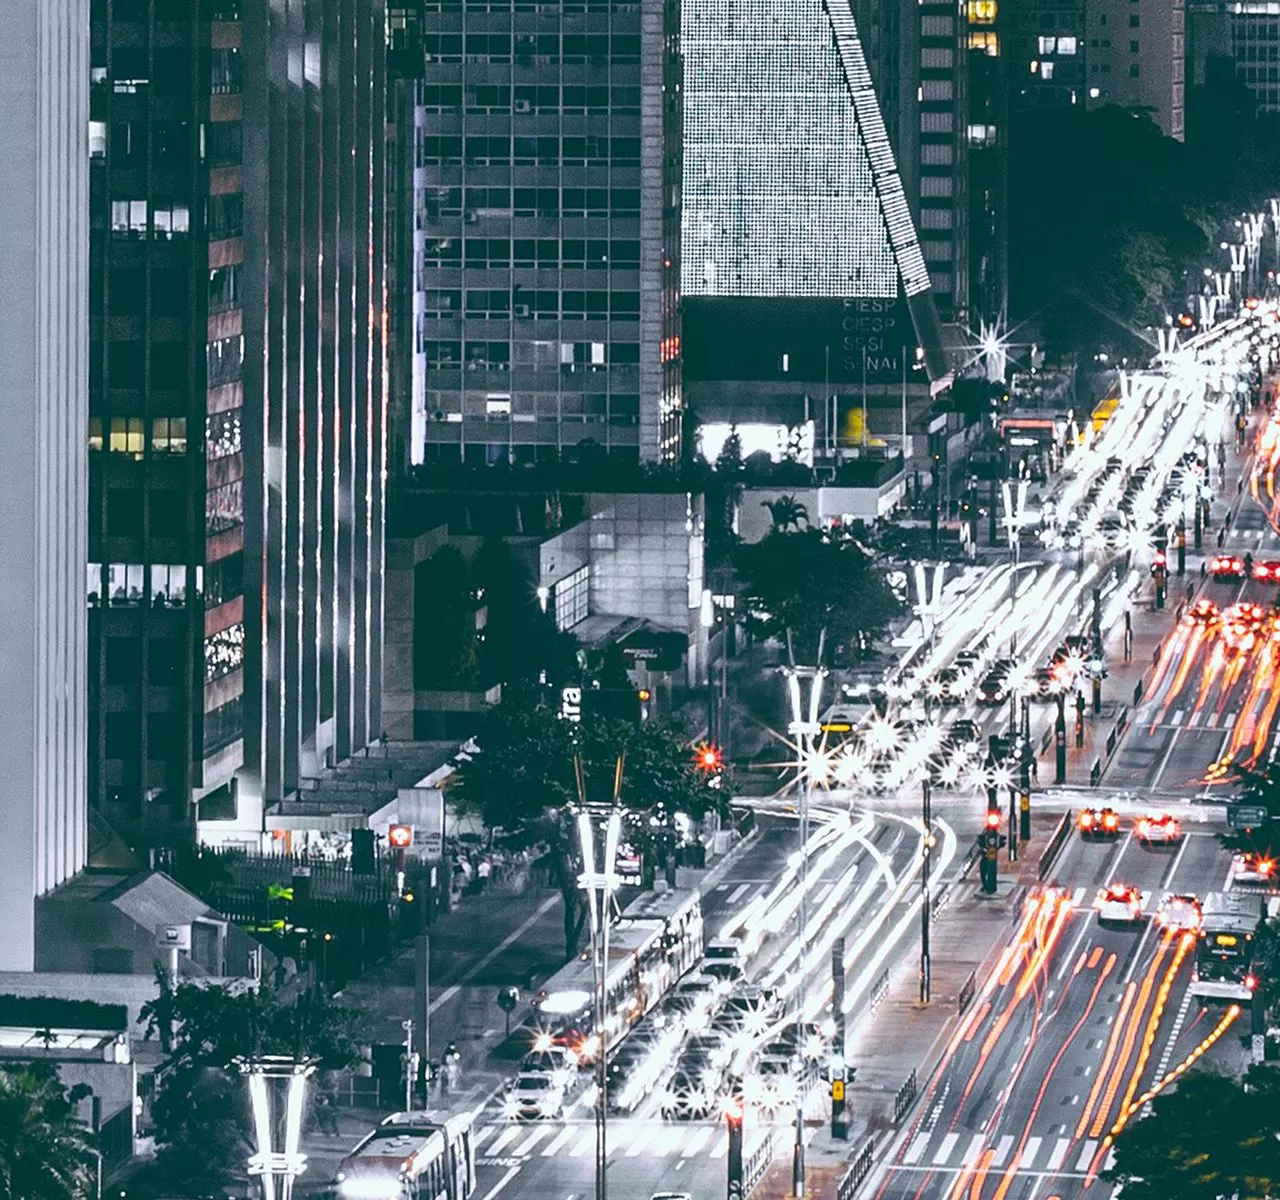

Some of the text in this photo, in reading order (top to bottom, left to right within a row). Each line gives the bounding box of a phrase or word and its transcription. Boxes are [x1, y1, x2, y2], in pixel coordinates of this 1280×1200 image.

[843, 299, 896, 312] FIESP
[842, 316, 896, 332] CIESP
[843, 336, 884, 351] SESI
[843, 356, 897, 371] SNAI
[558, 687, 581, 722] ira
